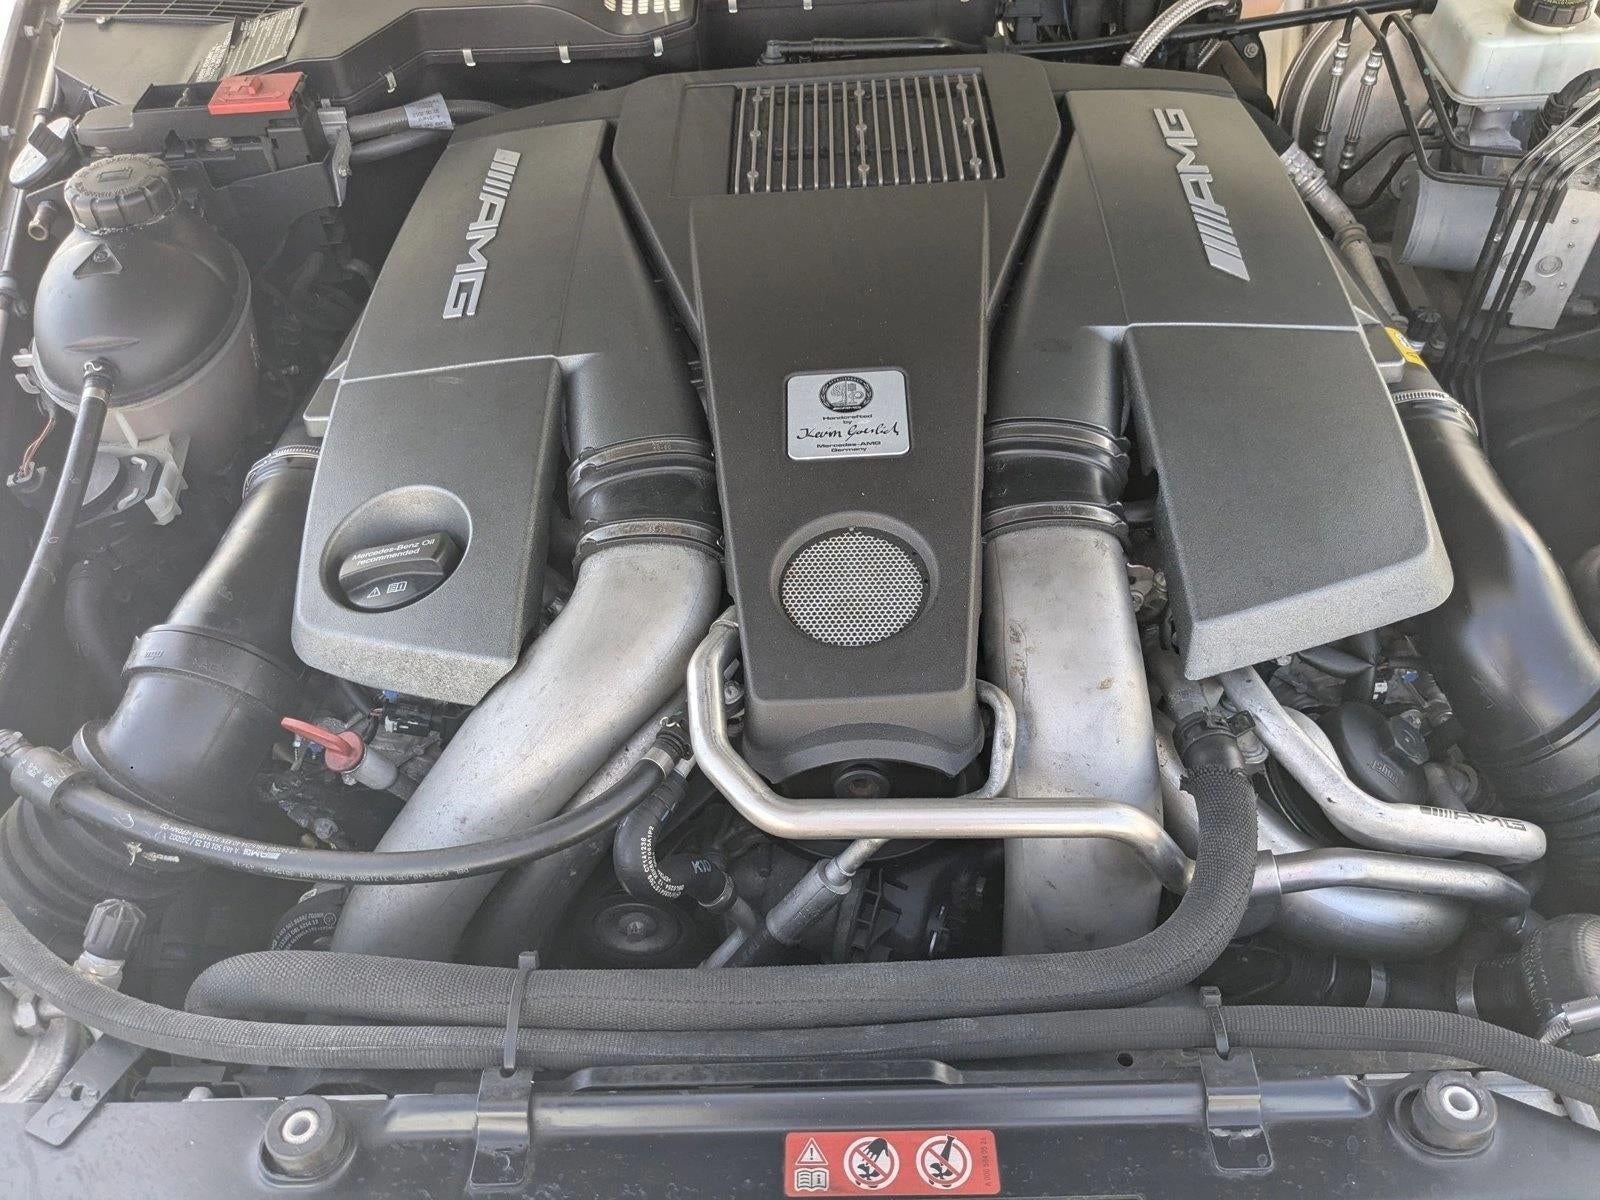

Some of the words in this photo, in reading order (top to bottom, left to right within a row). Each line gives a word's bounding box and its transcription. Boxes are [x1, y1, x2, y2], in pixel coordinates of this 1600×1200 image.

[442, 191, 507, 320] AMG
[822, 413, 873, 421] Handcrafted
[816, 440, 881, 449] Mercedes-AMG
[351, 542, 420, 561] Mercedes-Benz
[421, 538, 436, 547] Oil
[356, 547, 421, 567] recommended
